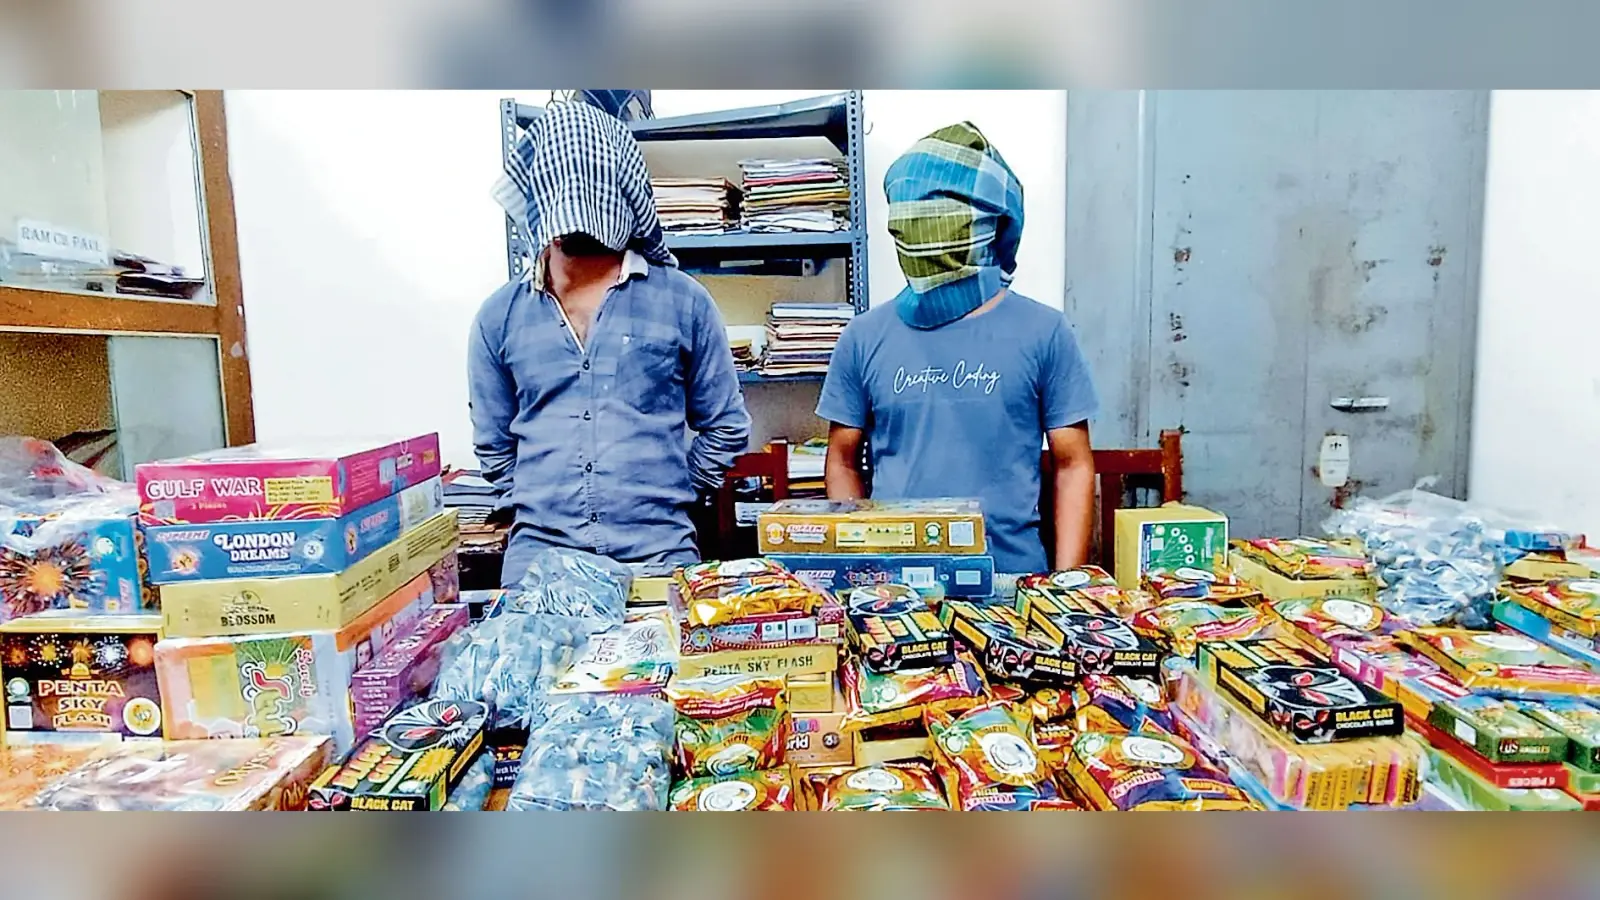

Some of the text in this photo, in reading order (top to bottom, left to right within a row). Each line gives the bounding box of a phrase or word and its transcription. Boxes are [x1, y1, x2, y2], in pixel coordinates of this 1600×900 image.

[21, 226, 50, 243] RAM
[894, 360, 1000, 394] Creative Coding
[146, 479, 205, 498] GULF
[211, 476, 264, 496] WAR
[155, 530, 211, 542] SUPREME
[213, 531, 298, 550] LONDON
[230, 548, 290, 563] DREAMS
[220, 614, 276, 627] BLOSSOM
[901, 641, 948, 655] BLACK CAT
[1114, 652, 1158, 661] BLACK CAT
[747, 660, 771, 673] SKY
[1035, 656, 1076, 673] BLACK CAT
[38, 680, 125, 697] PENTA
[58, 697, 107, 712] SKY
[53, 712, 113, 728] FLASH
[1335, 708, 1394, 722] BLACK CAT
[351, 797, 415, 811] BLACK CAT
